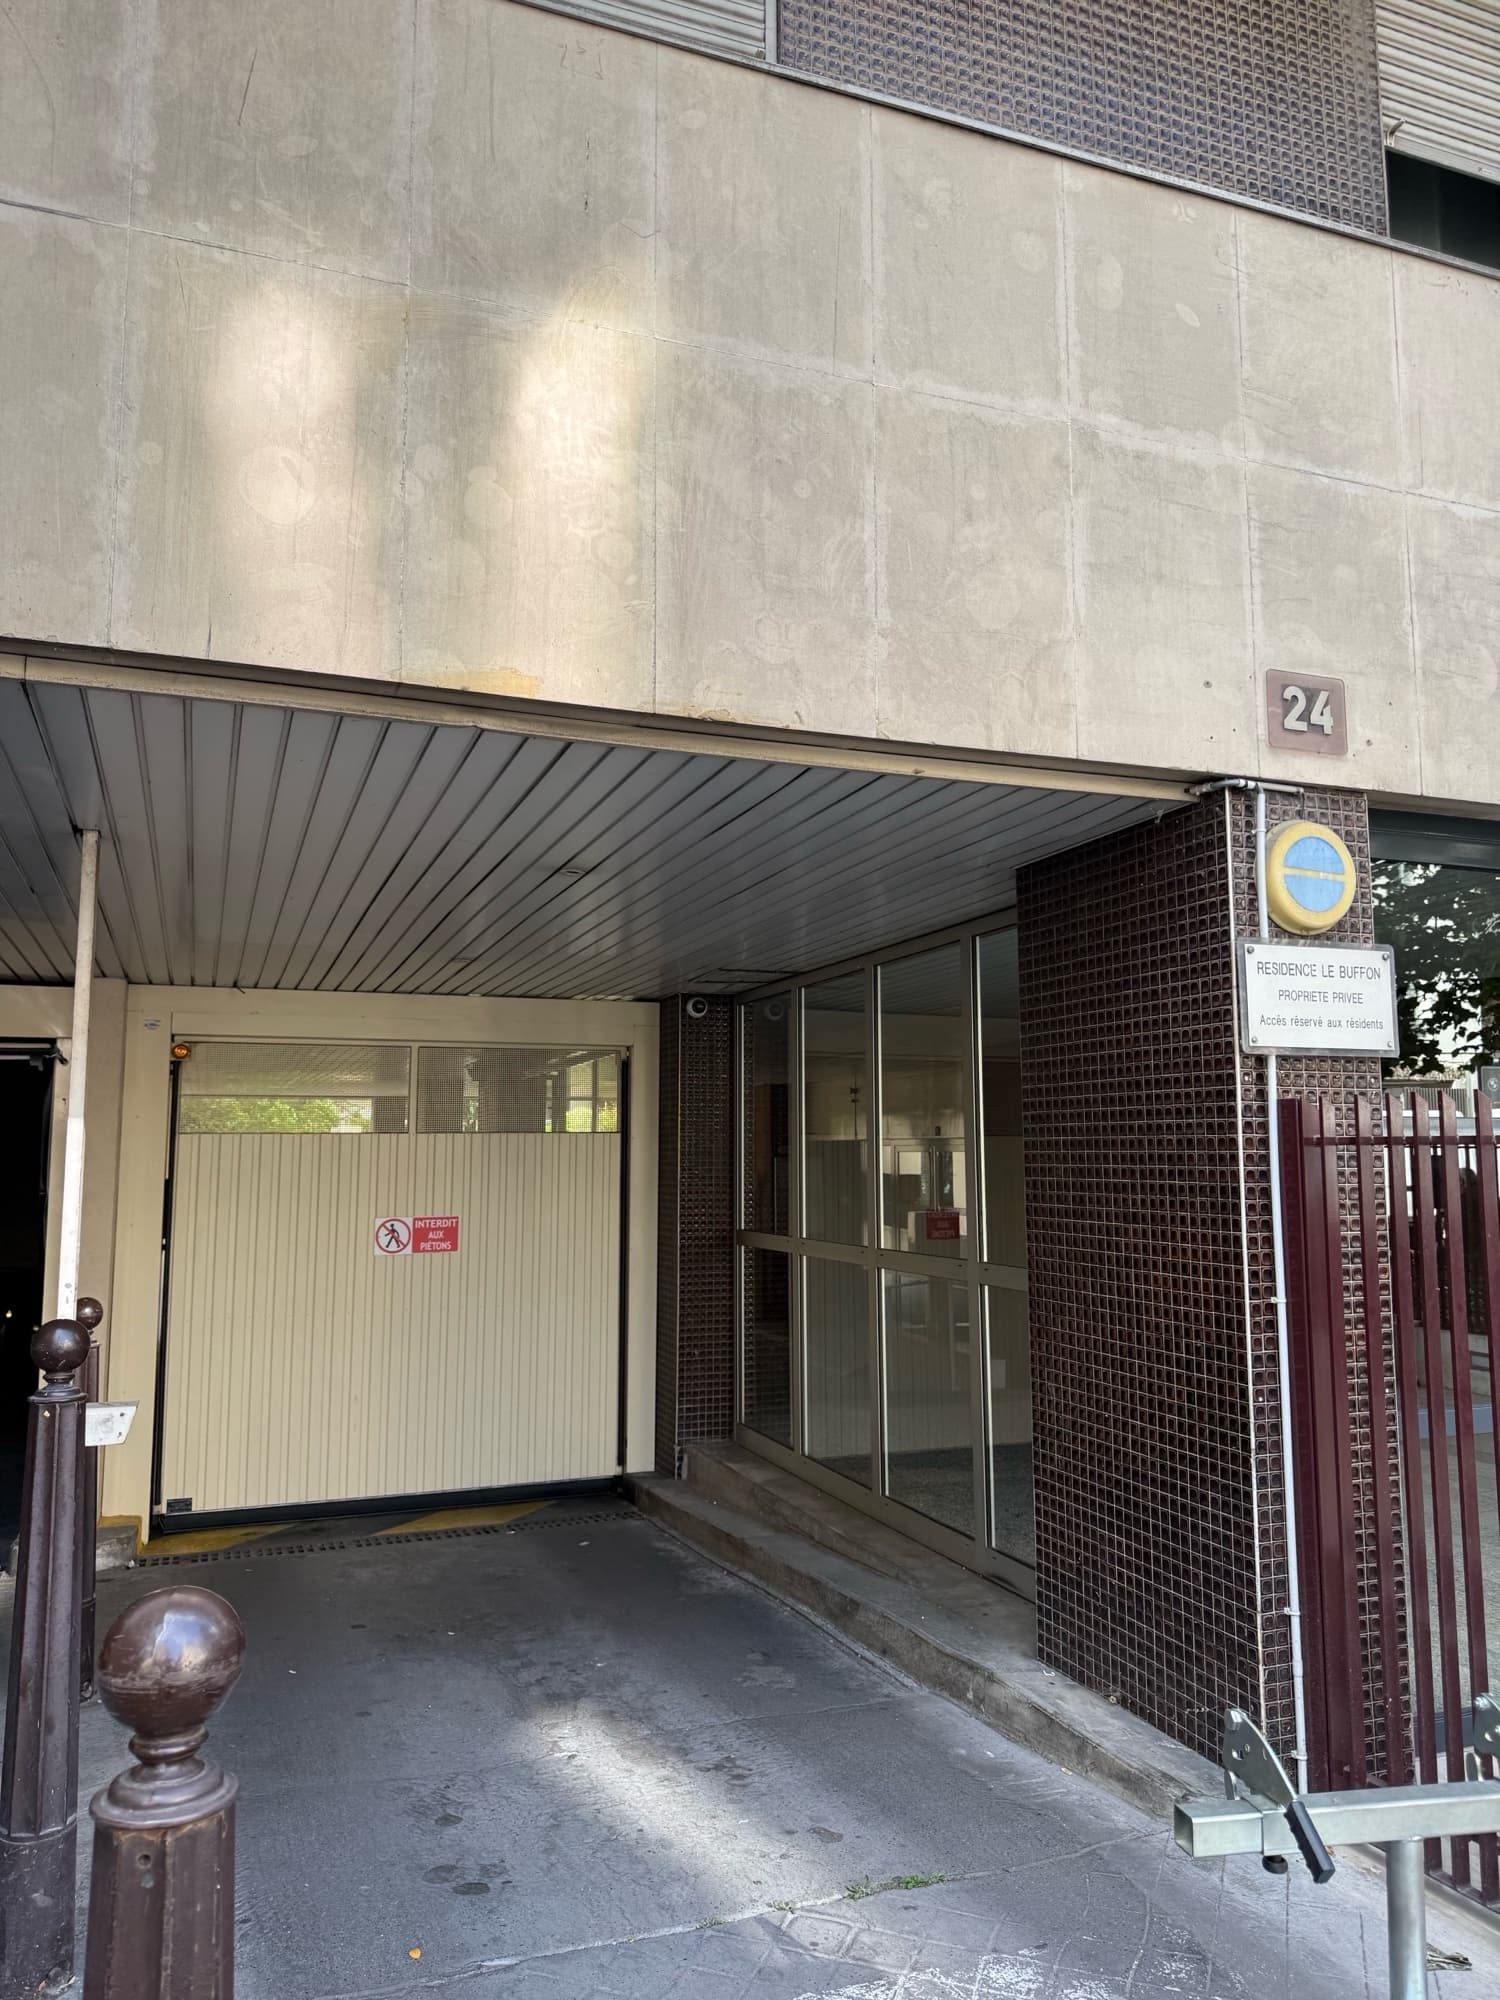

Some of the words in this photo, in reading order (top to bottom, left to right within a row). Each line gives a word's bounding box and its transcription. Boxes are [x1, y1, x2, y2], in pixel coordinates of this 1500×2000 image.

[1283, 685, 1334, 735] 24
[1257, 961, 1317, 977] RESIDENCE
[1321, 964, 1335, 978] LE
[1339, 965, 1381, 980] BUFFON
[1278, 989, 1329, 1003] PROPRIETE
[1332, 991, 1364, 1004] PRIVEE
[1290, 1015, 1323, 1027] réservé
[1327, 1019, 1343, 1028] aux
[1346, 1018, 1384, 1030] résidents
[415, 1219, 458, 1229] INTERDIT
[427, 1230, 444, 1239] AUX
[420, 1240, 451, 1251] PIÉTONS
